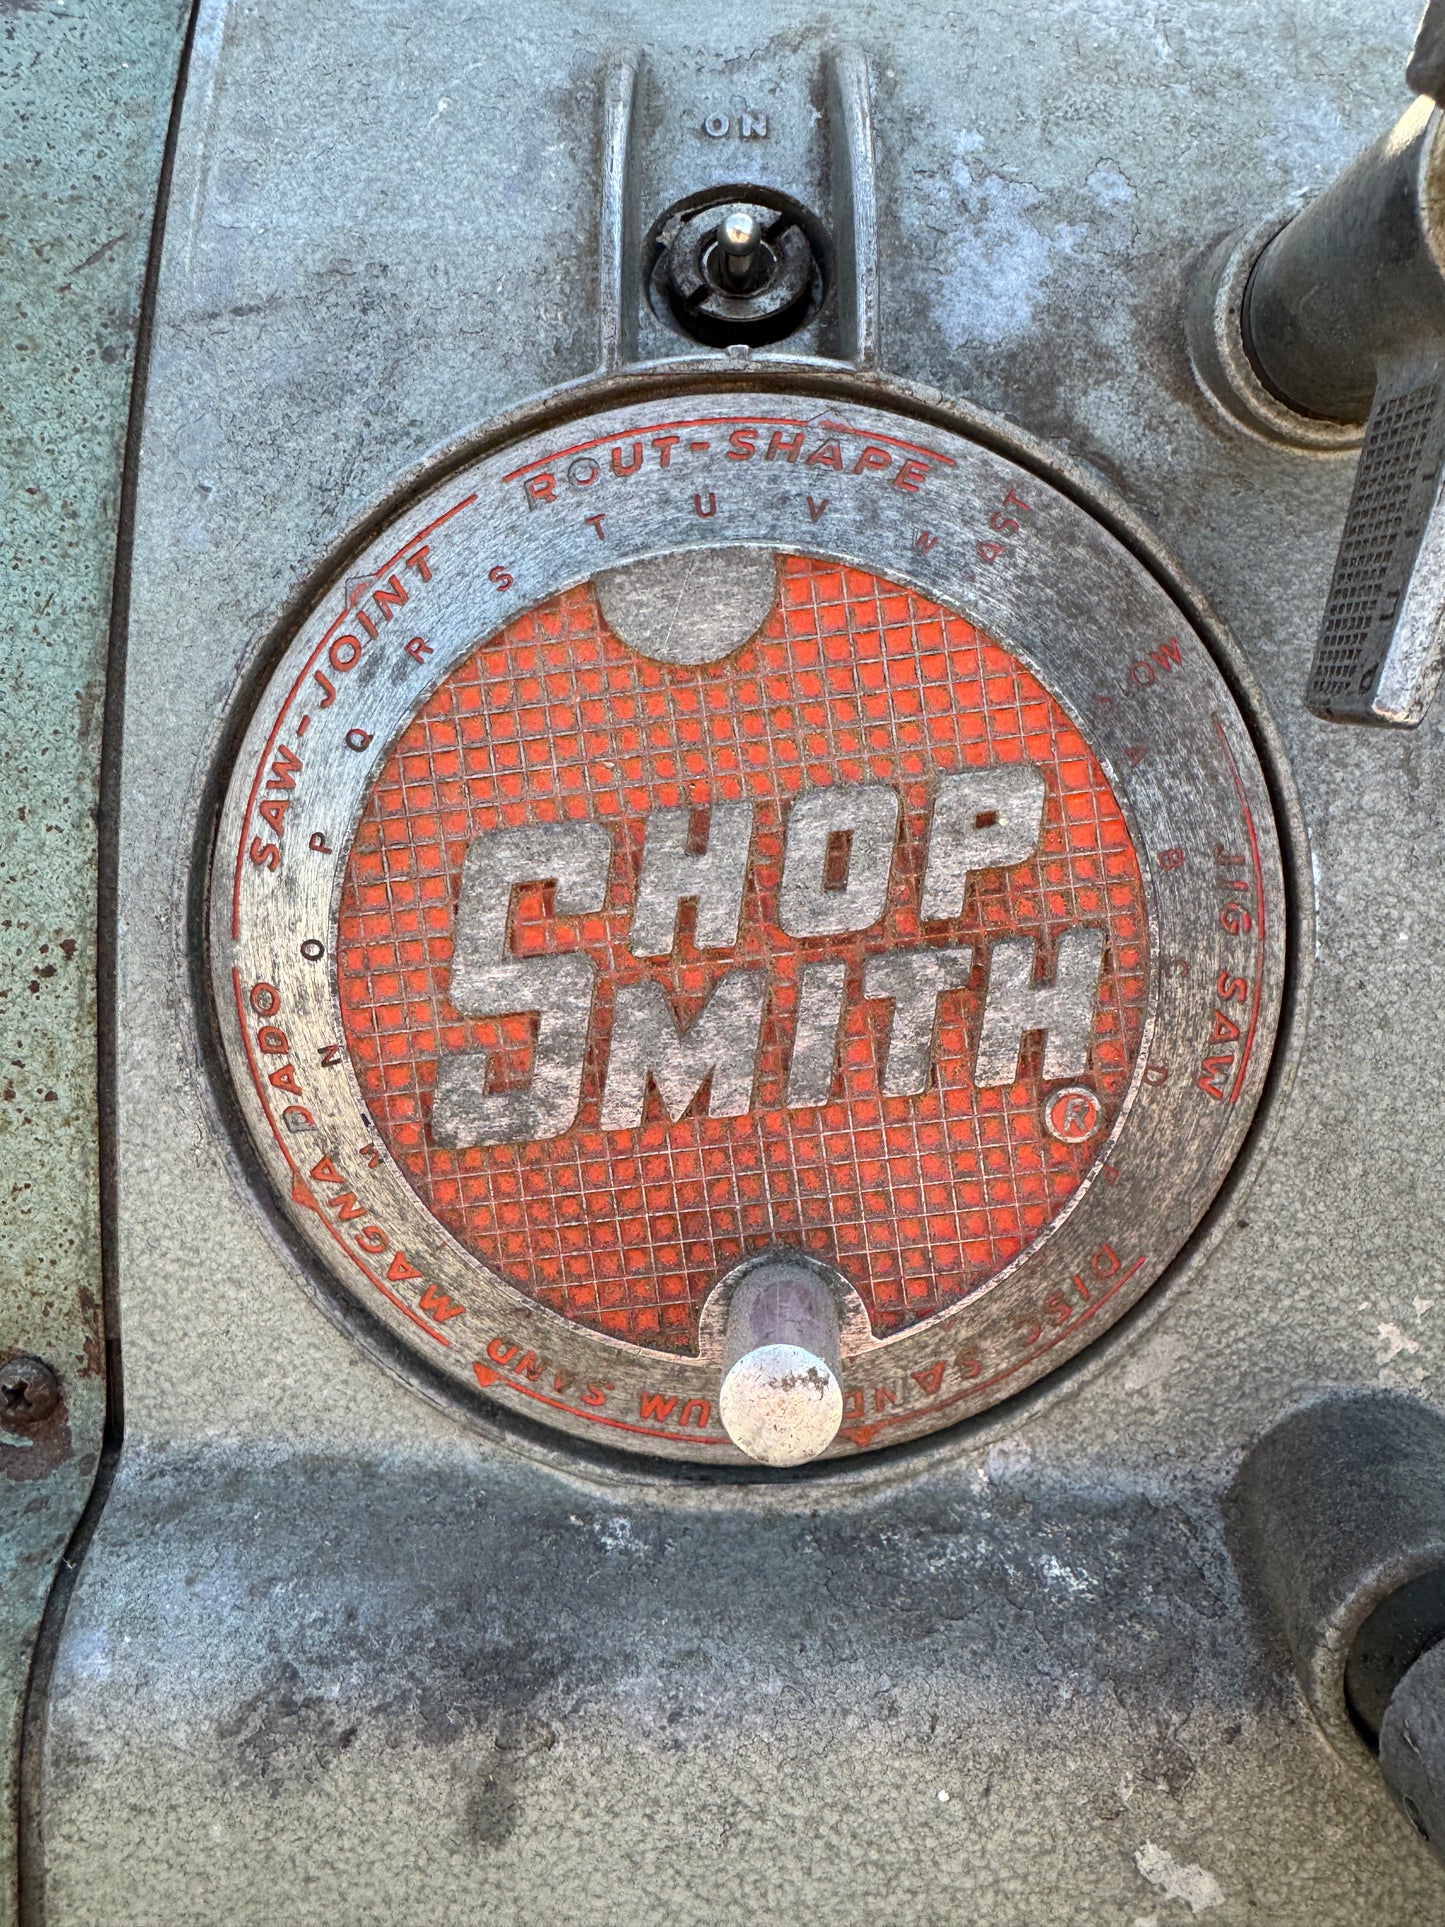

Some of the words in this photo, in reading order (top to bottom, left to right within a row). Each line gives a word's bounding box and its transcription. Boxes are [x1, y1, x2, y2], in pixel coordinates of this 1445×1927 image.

[704, 112, 767, 137] ON
[524, 429, 932, 512] ROUT-SHAPE
[584, 513, 607, 541] T
[693, 492, 717, 519] U
[806, 496, 830, 523] V
[488, 565, 514, 592] S
[405, 636, 434, 665] R
[250, 545, 433, 872] SAW-JOINT
[345, 727, 374, 753] Q
[308, 831, 333, 855] P
[452, 761, 1047, 985] CHOP
[1213, 843, 1252, 934] JIG
[249, 982, 319, 1134] DADO
[431, 926, 1103, 1151] SMITH
[1197, 969, 1248, 1100] SAW
[310, 1155, 467, 1324] MAGNA
